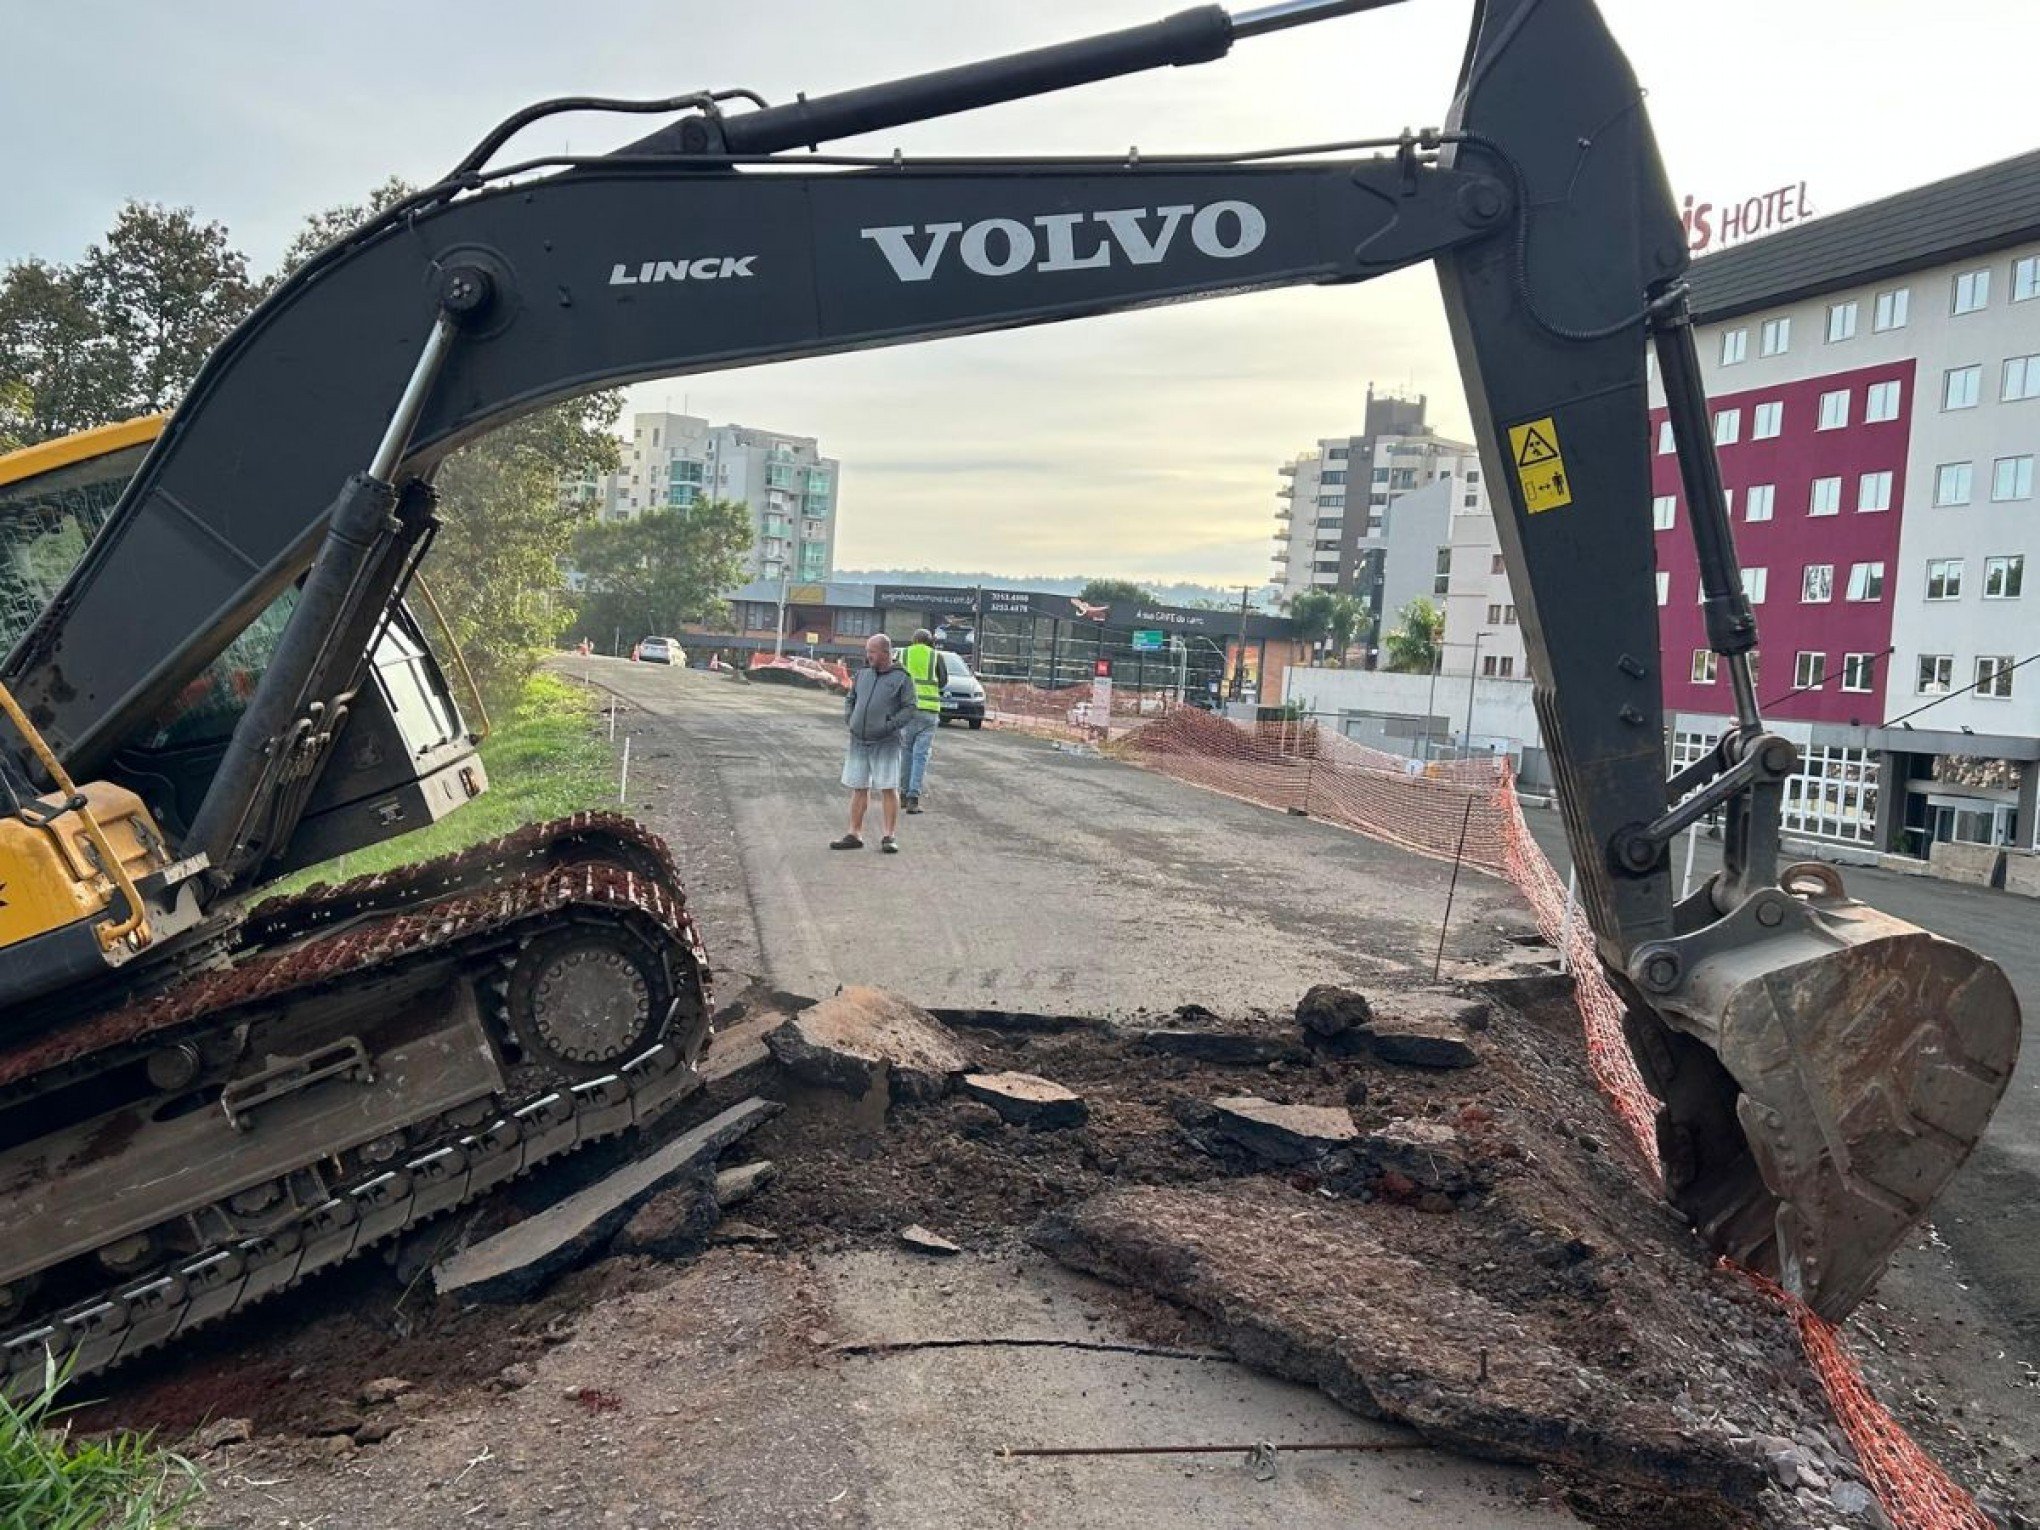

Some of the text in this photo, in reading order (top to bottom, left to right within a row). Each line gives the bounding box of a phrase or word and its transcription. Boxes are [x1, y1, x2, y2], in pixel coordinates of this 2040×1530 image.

[861, 200, 1267, 282] VOLVO
[1682, 181, 1813, 250] is HOTEL
[609, 254, 758, 285] LINCK
